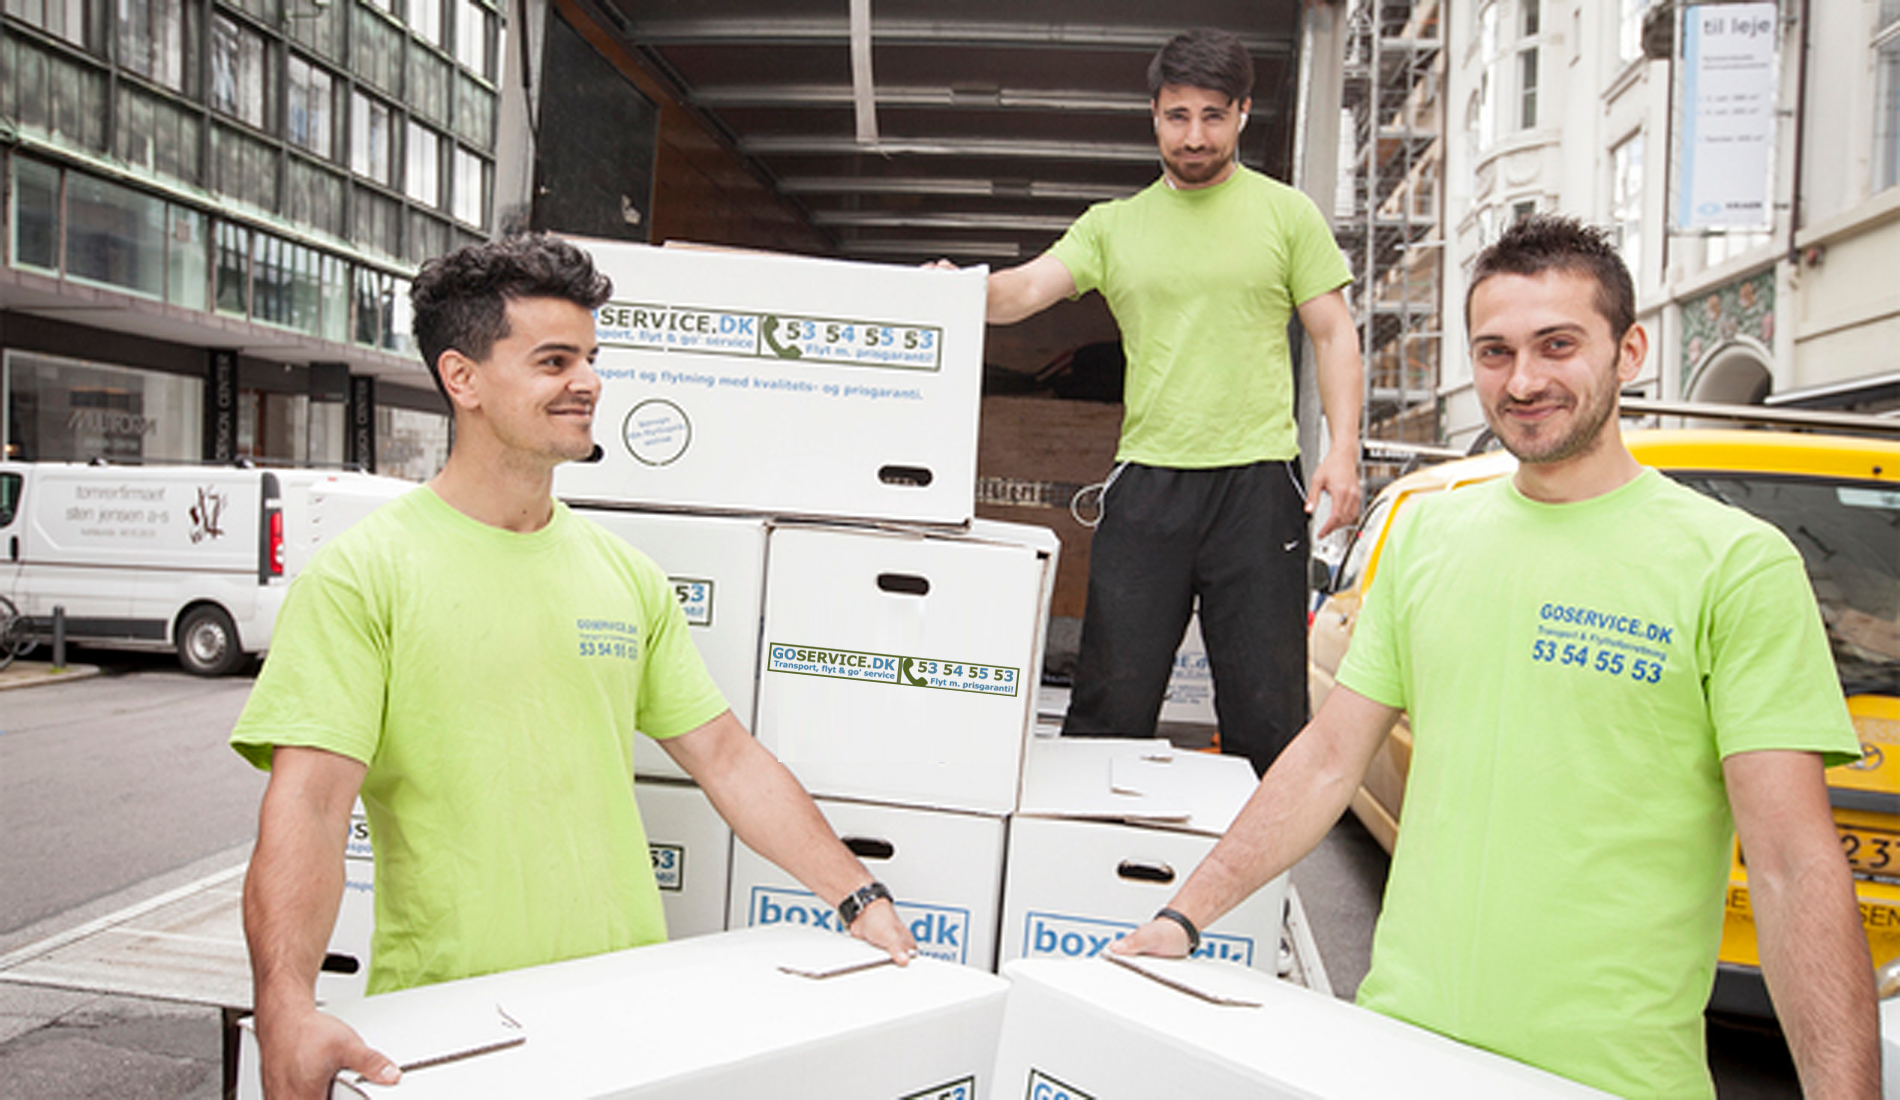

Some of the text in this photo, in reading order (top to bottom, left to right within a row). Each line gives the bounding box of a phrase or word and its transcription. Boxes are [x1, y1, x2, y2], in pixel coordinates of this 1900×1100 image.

[1704, 17, 1771, 37] til leje
[593, 307, 755, 335] SERVICE.DK
[786, 321, 933, 349] 53 54 55 53
[640, 371, 657, 383] og
[661, 370, 715, 388] flytning
[719, 377, 749, 388] med
[823, 384, 839, 396] og
[675, 583, 704, 604] 53
[1540, 603, 1674, 644] GOSERVICE.DK
[580, 642, 595, 656] 53
[773, 647, 896, 671] GOSERVICE.DK
[774, 659, 819, 673] Transport,
[821, 664, 837, 674] flyt
[864, 670, 895, 680] service
[917, 661, 1014, 682] 53 54 55 53
[1532, 639, 1663, 684] 53 54 55 53
[930, 677, 947, 687] Flyt
[962, 681, 1014, 693] prisgaranti!
